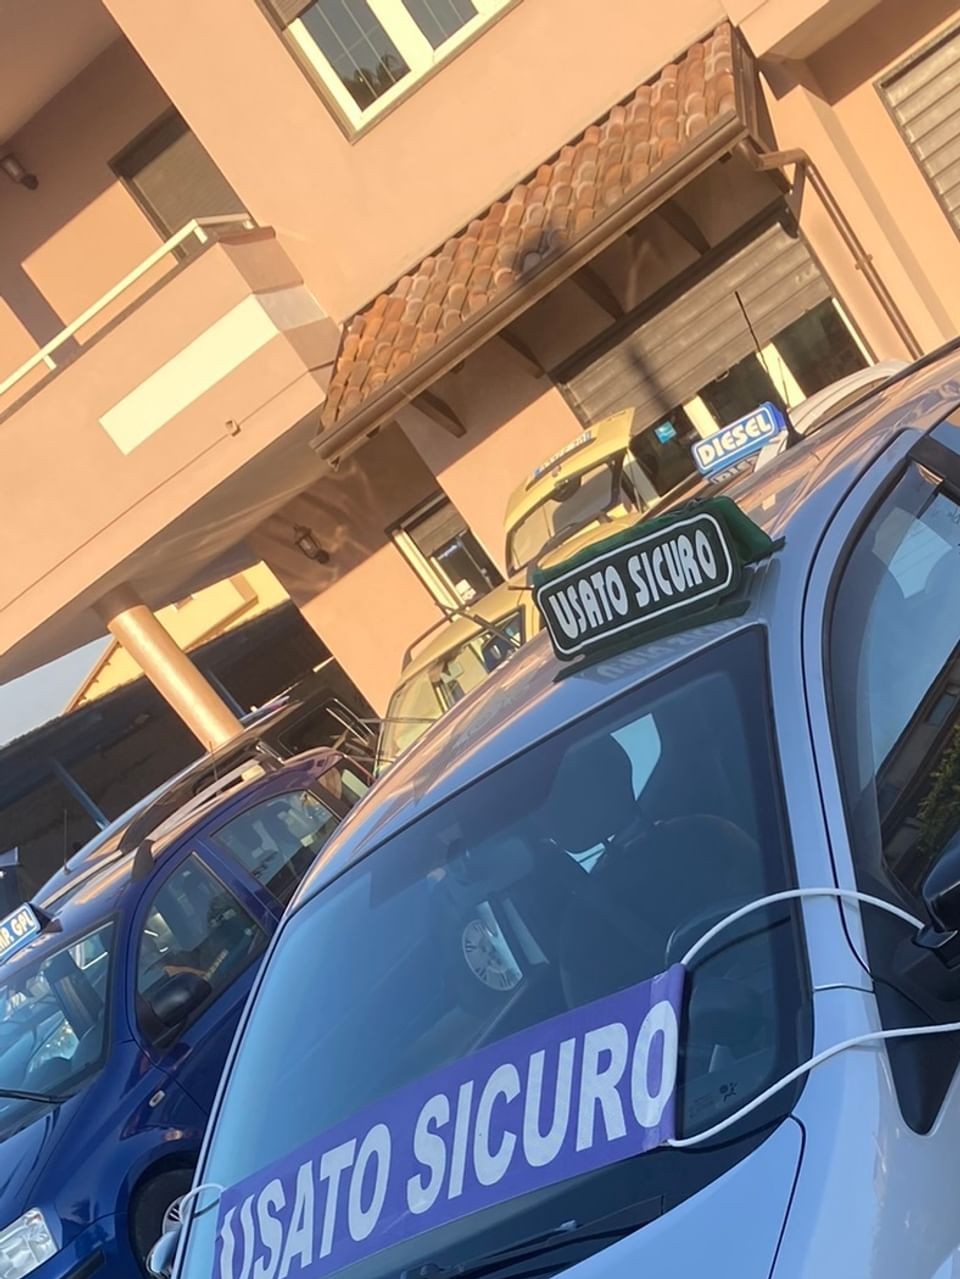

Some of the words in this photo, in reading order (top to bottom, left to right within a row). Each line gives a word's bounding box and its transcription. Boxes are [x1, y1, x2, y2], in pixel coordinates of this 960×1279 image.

[698, 413, 772, 466] DIESEL
[548, 565, 629, 640] USATO
[627, 529, 717, 607] SICURO
[11, 910, 34, 937] GPL
[406, 1000, 679, 1215] SICURO
